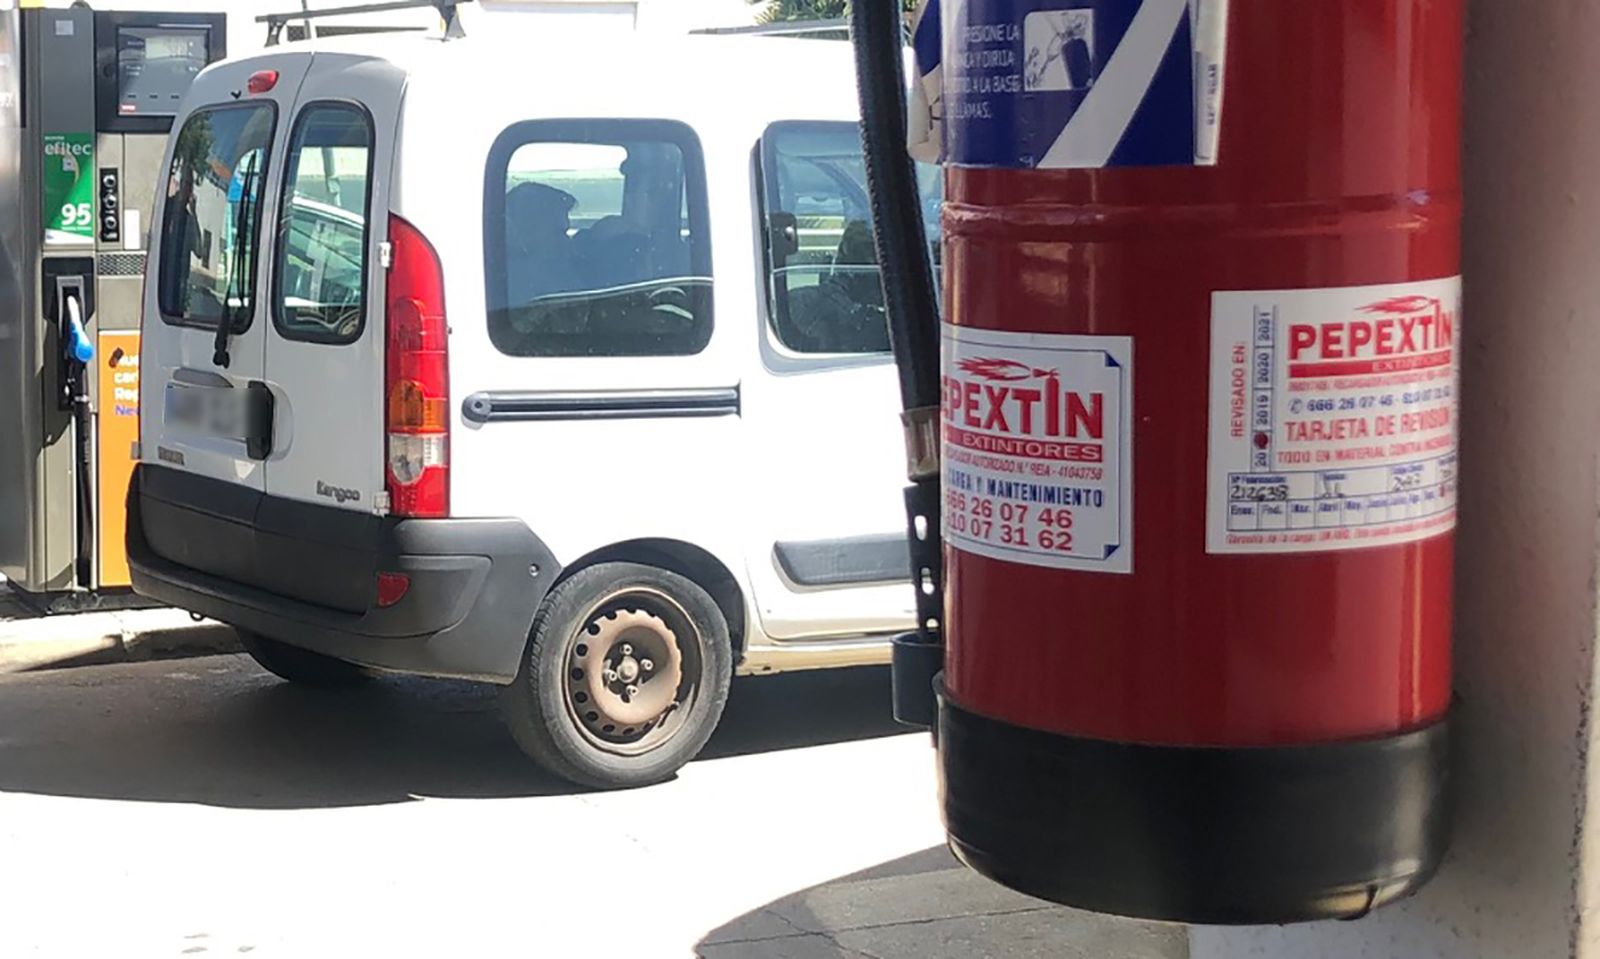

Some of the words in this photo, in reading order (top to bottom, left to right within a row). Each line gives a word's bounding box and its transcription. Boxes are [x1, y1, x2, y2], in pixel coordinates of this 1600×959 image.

[45, 142, 92, 155] efitec
[61, 203, 92, 225] 95
[1258, 312, 1271, 342] 2021
[1288, 306, 1452, 361] PEPEXTIN
[1257, 353, 1270, 383] 2020
[1231, 367, 1245, 438] REVISADO
[1256, 395, 1269, 425] 2019
[1285, 418, 1369, 442] TARJETA
[1375, 415, 1396, 437] DE
[963, 433, 1100, 459] EXTINTORES
[1277, 450, 1311, 464] TODO
[987, 477, 1104, 508] MANTENIMIENTO
[971, 496, 993, 519] 26
[1000, 503, 1028, 524] 07
[1037, 508, 1073, 529] 46
[971, 518, 993, 539] 07
[1000, 525, 1029, 546] 31
[1038, 530, 1073, 551] 62
